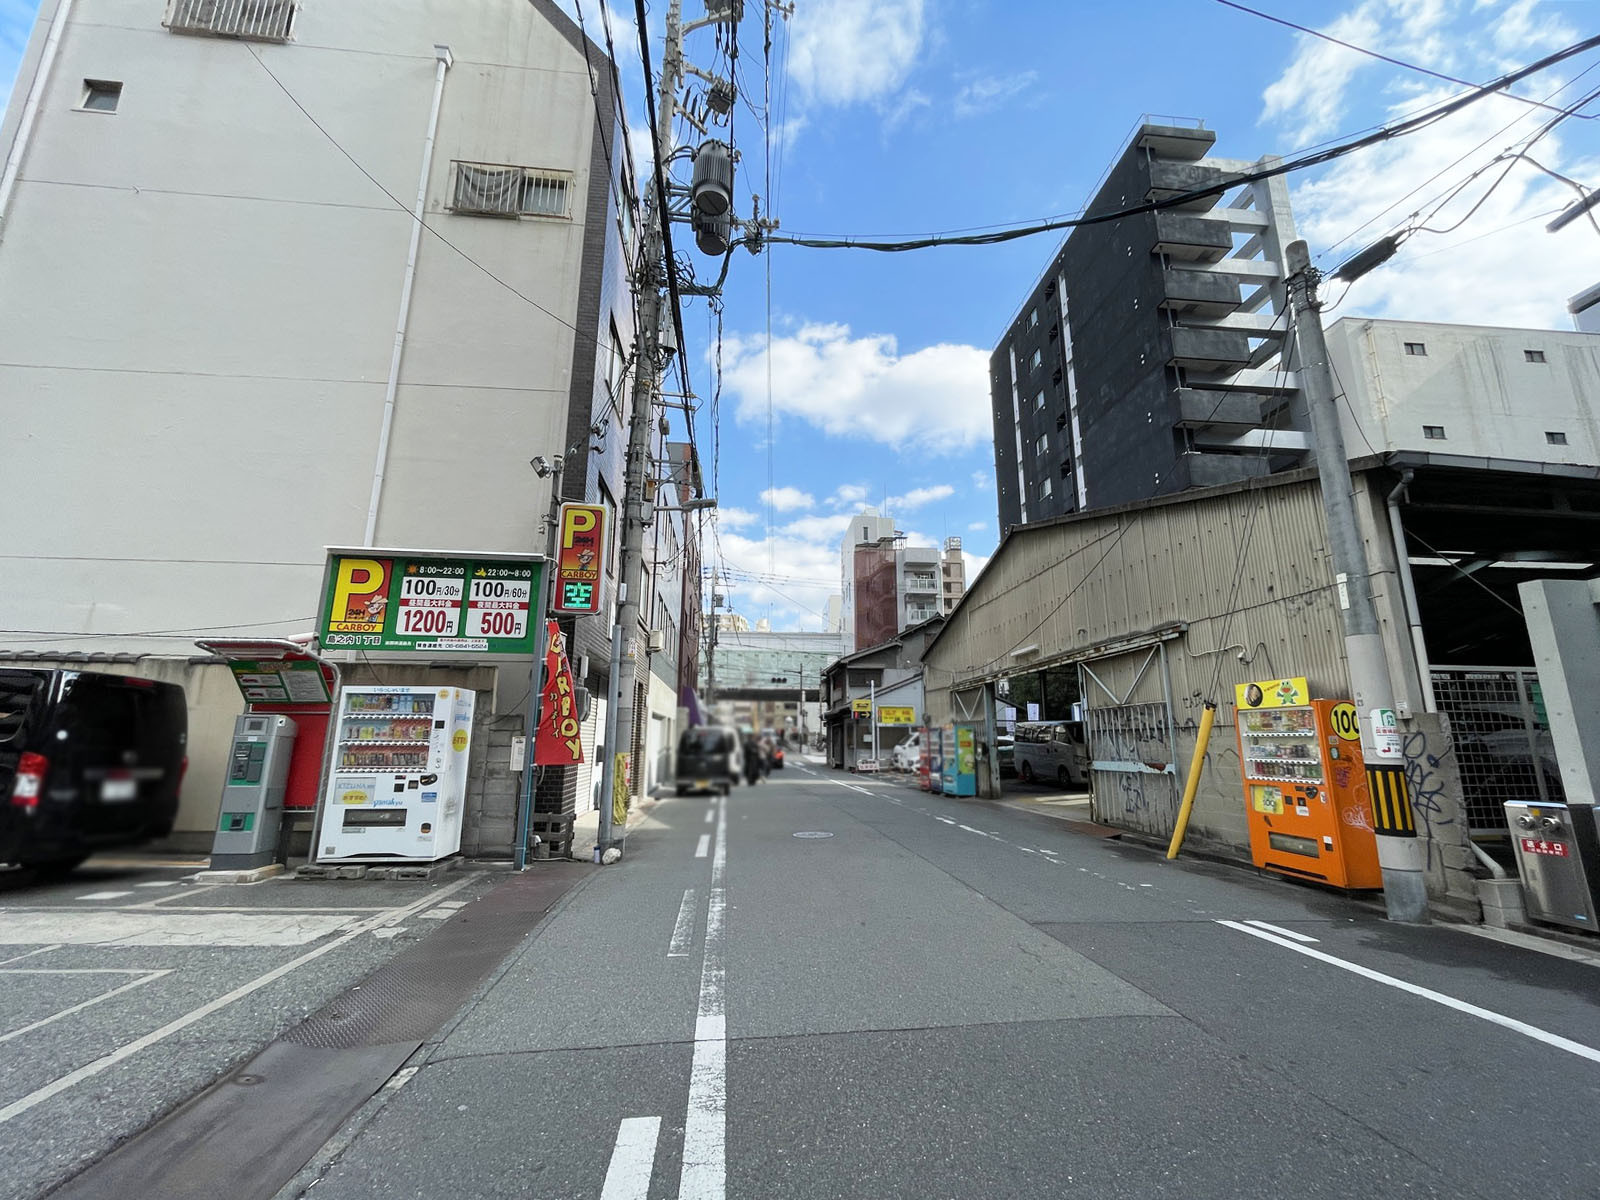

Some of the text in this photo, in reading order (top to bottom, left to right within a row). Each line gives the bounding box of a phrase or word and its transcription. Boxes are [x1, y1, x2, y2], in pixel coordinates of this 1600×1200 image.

[563, 509, 596, 548] P
[331, 559, 384, 621] P
[564, 582, 593, 608] 空
[336, 623, 376, 631] CARBOY
[404, 609, 454, 633] 1200円
[480, 612, 522, 635] 500円
